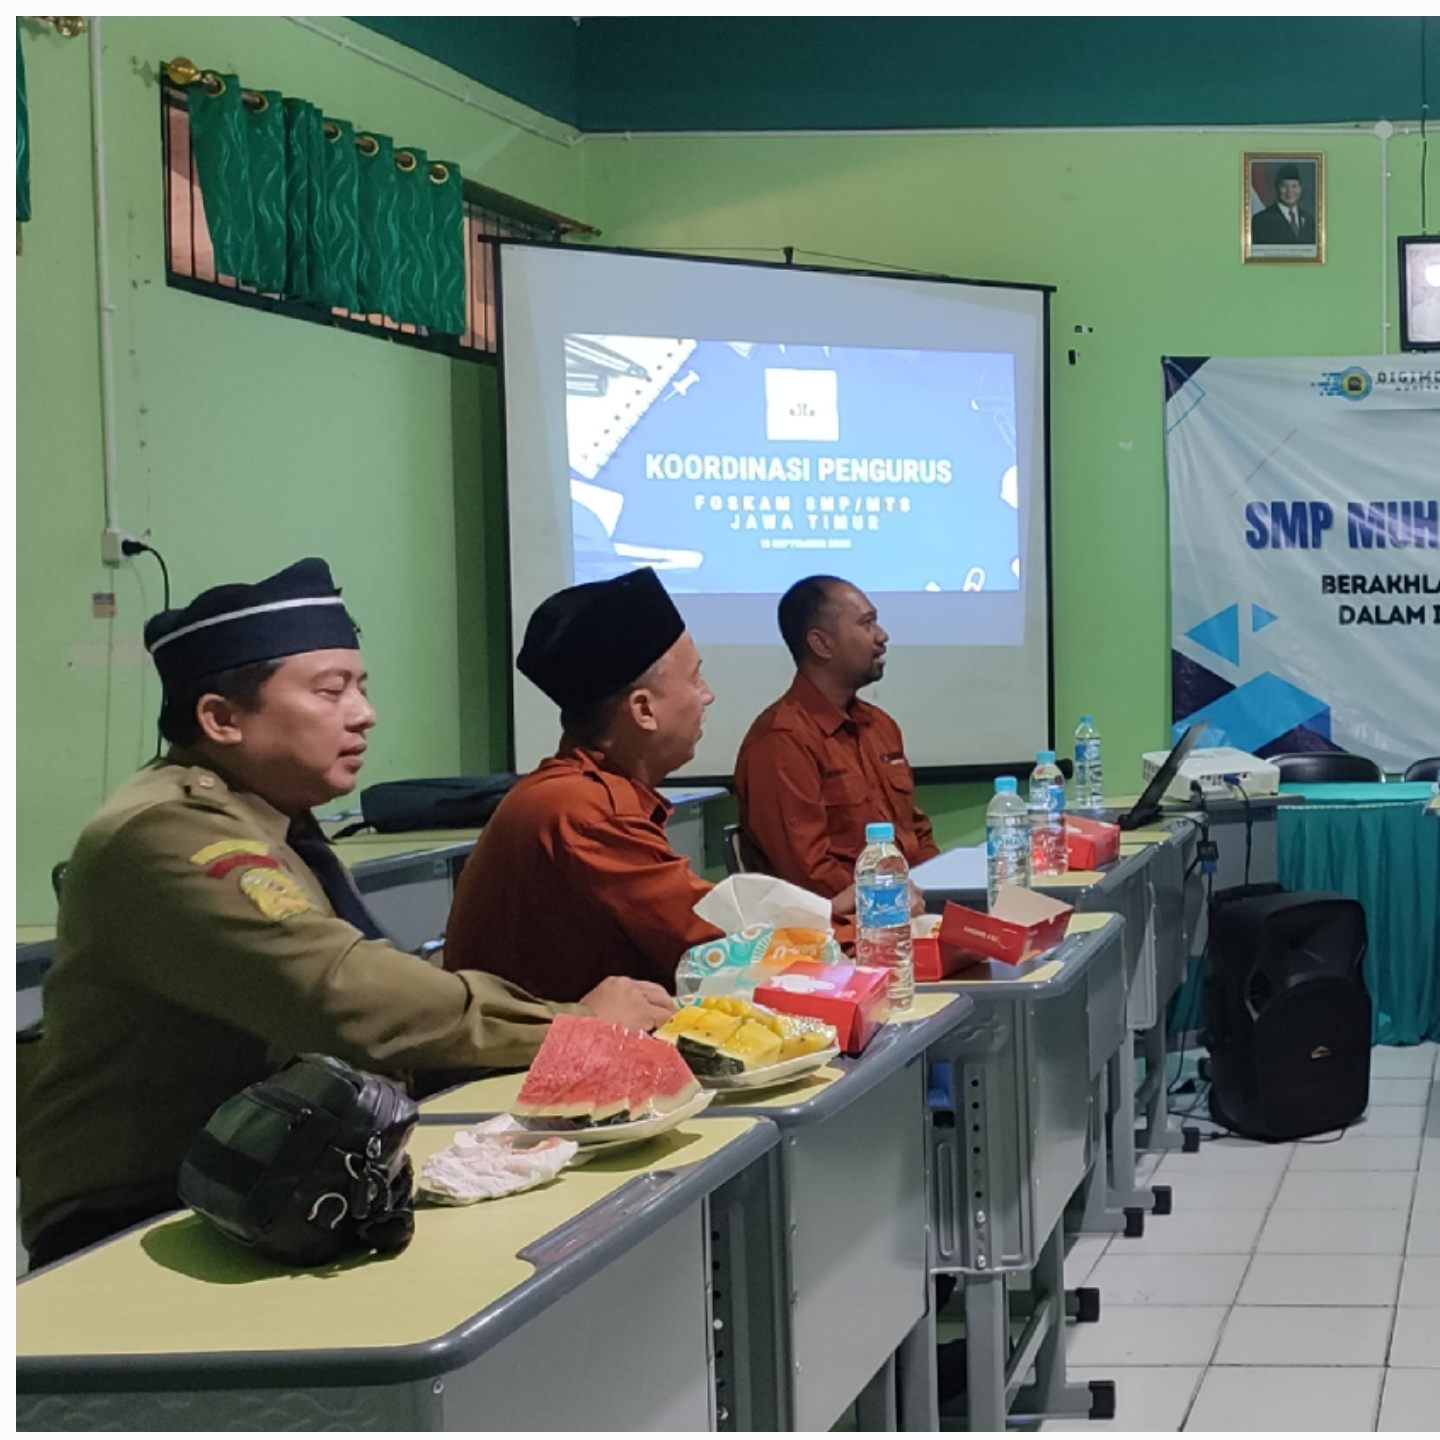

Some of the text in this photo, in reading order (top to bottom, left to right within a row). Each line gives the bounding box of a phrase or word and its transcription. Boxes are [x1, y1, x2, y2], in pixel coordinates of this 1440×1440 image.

[645, 454, 953, 484] KOORDINASI PENGURUS
[694, 495, 791, 511] FOSKAM
[730, 514, 880, 530] JAWA TIMUR
[1245, 501, 1334, 549] SMP
[1338, 604, 1425, 625] DALAM
